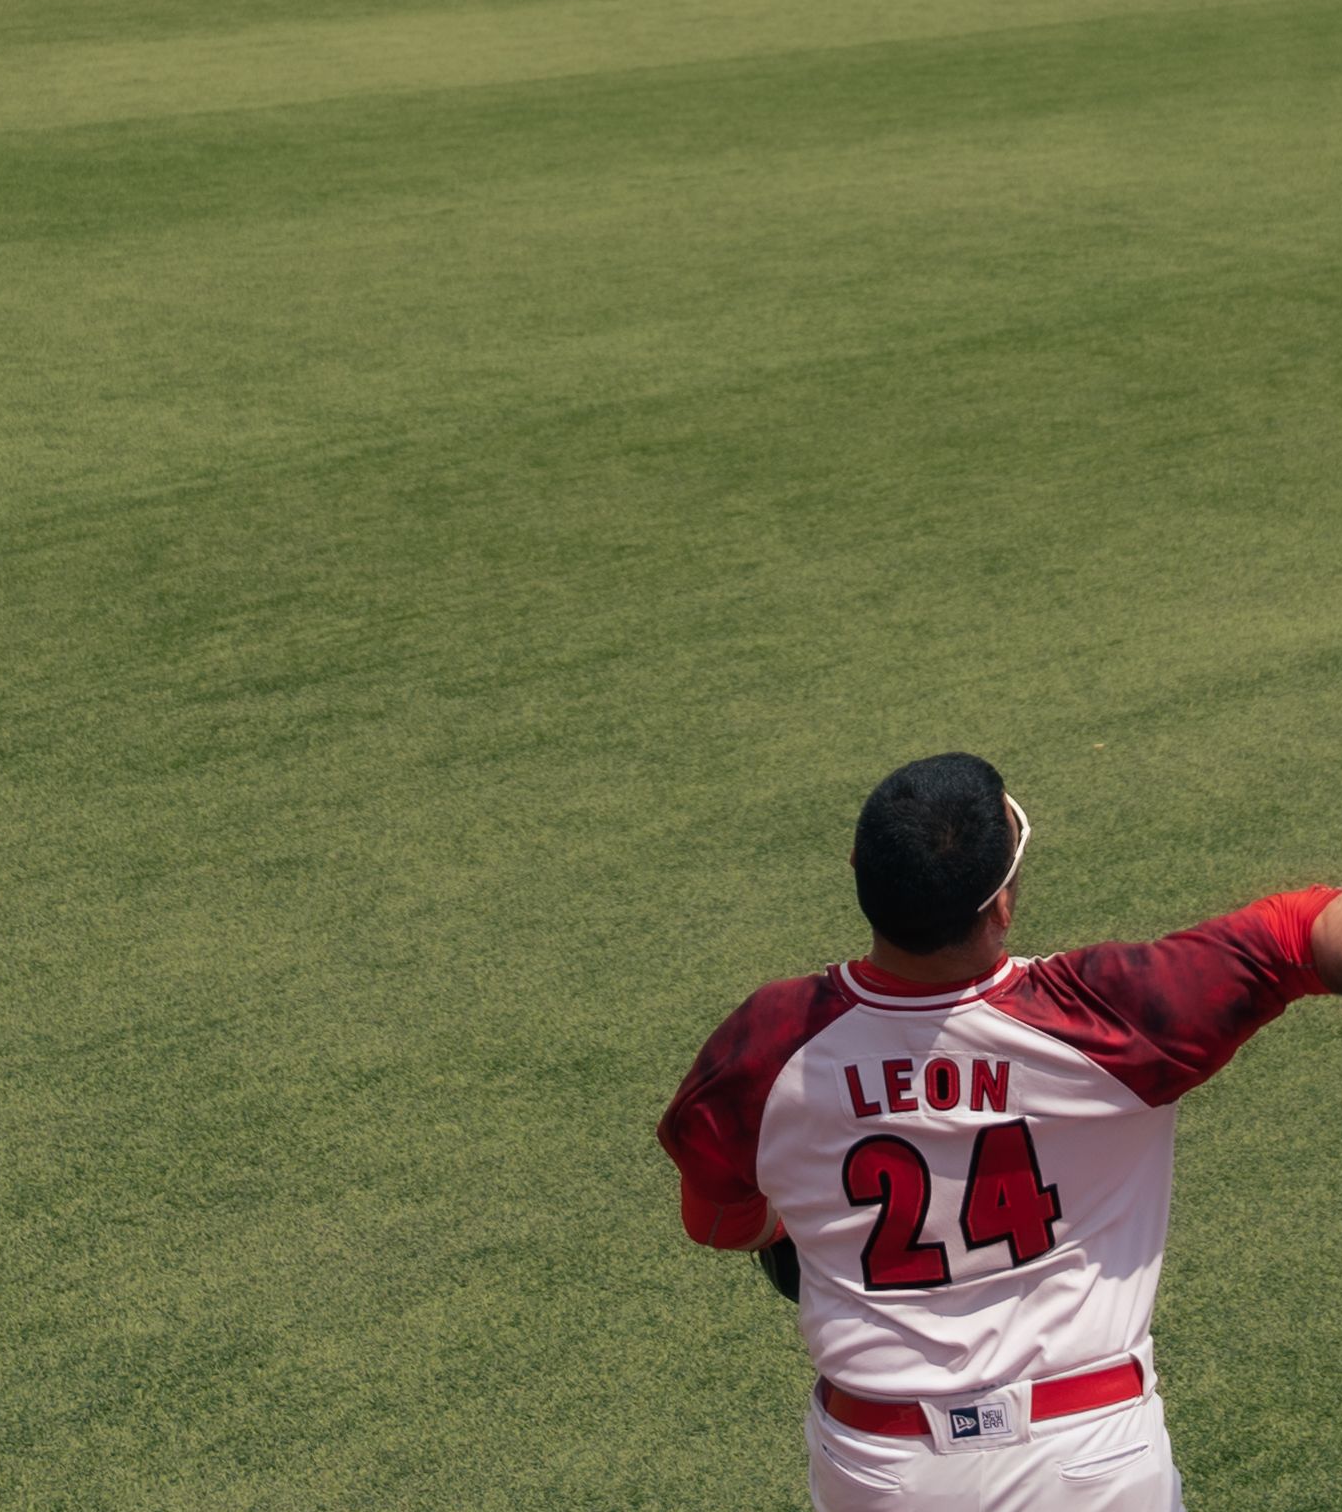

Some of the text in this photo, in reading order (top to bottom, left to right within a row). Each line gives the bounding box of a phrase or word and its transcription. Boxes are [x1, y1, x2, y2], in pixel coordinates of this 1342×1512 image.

[844, 1057, 1011, 1119] LEON
[842, 1118, 1062, 1292] 24
[981, 1409, 1003, 1421] NEW
[983, 1418, 1005, 1430] ERA
